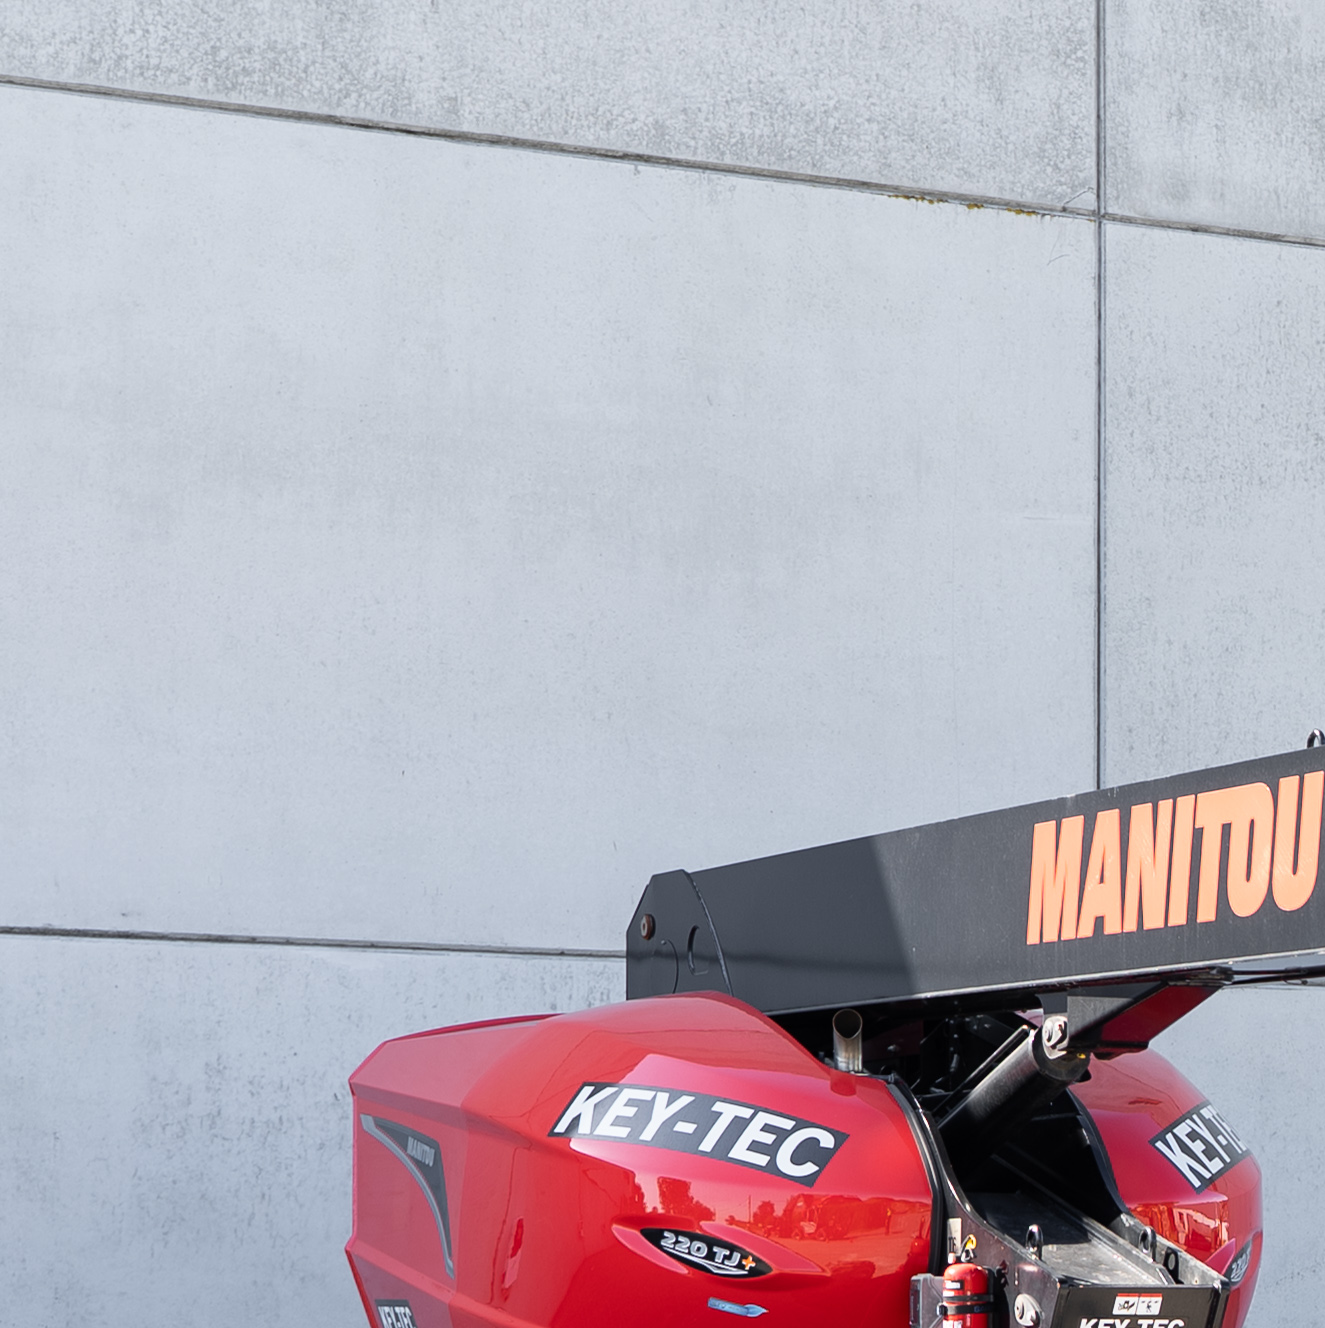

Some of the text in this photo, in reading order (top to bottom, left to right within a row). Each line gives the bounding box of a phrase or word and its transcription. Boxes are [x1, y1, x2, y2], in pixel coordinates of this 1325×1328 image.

[1026, 770, 1325, 945] MANITOU
[553, 1085, 836, 1177] KEY-TEC
[660, 1231, 708, 1257] 220
